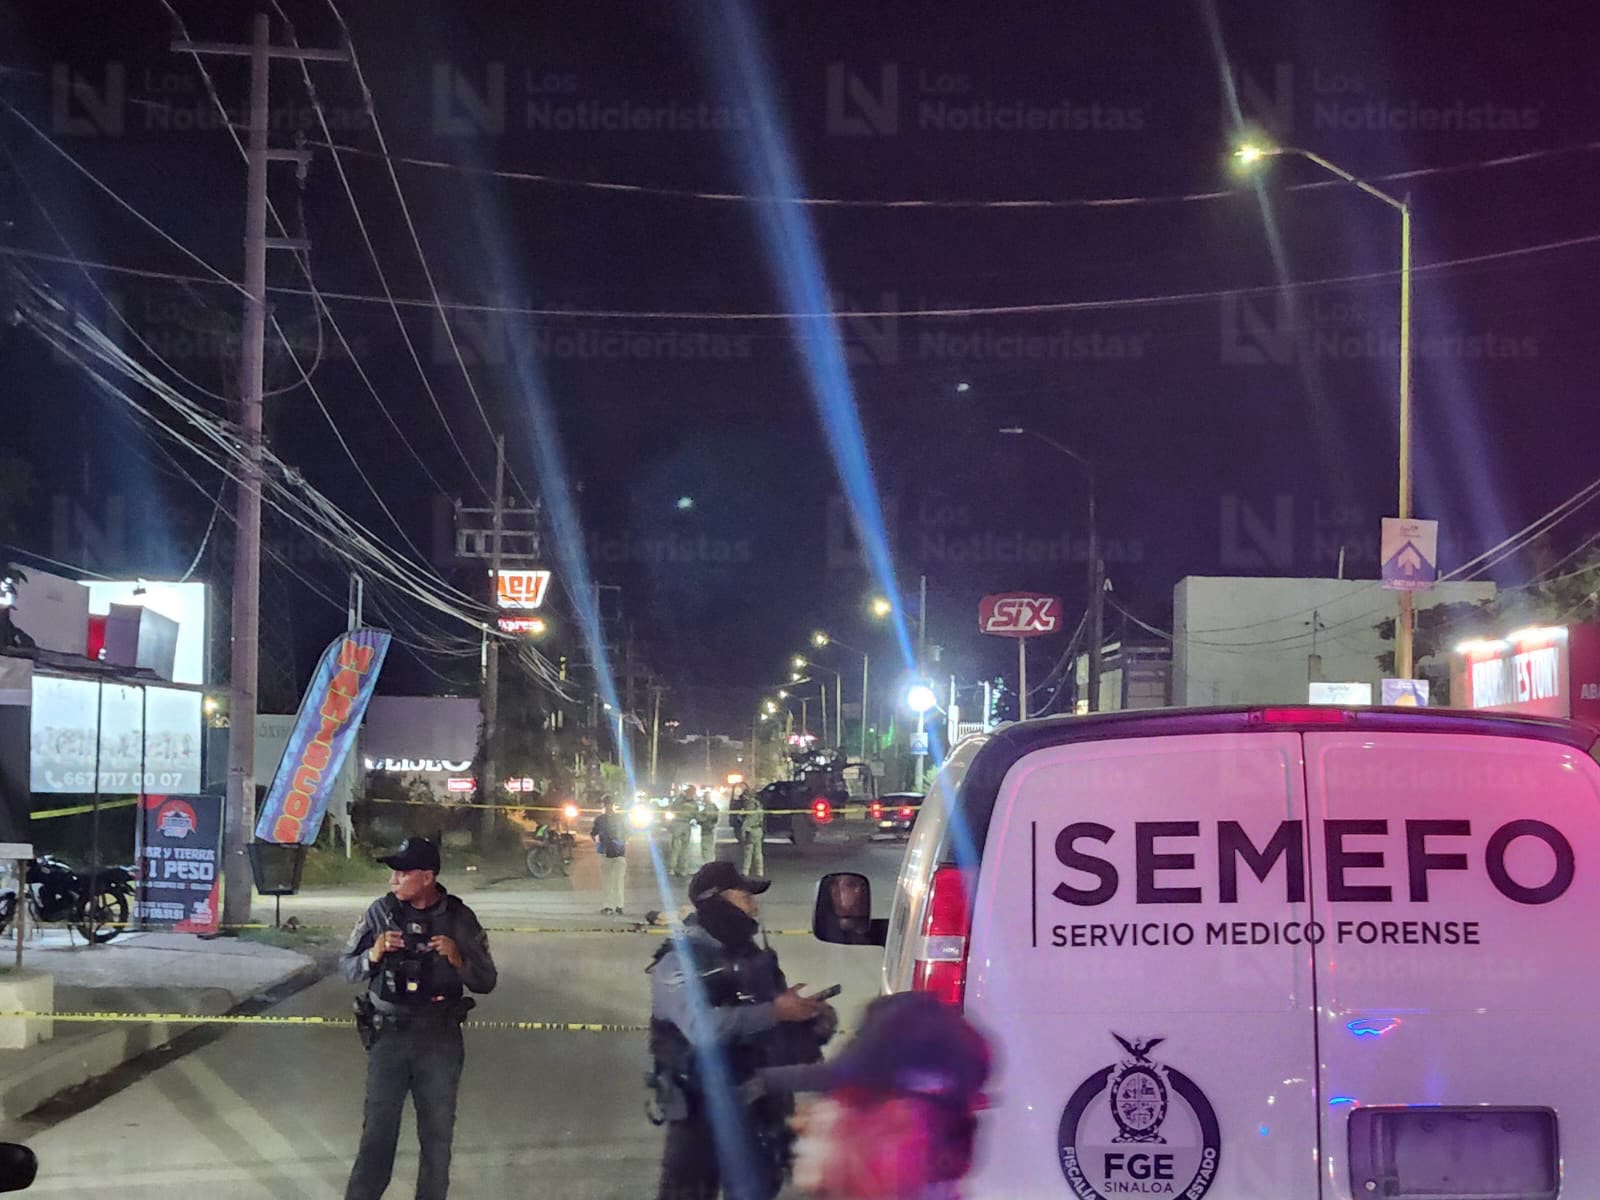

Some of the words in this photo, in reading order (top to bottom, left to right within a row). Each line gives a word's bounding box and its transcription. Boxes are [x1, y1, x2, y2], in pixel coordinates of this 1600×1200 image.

[64, 772, 97, 786] 667
[160, 773, 182, 787] 07
[164, 861, 214, 880] PESO
[1052, 818, 1575, 907] SEMEFO
[1052, 922, 1195, 948] SERVICIO
[1205, 921, 1326, 947] MEDICO
[1336, 920, 1481, 947] FORENSE
[1104, 1153, 1174, 1180] FGE
[1186, 1147, 1217, 1200] ESTADO
[1104, 1181, 1174, 1194] SINALOA
